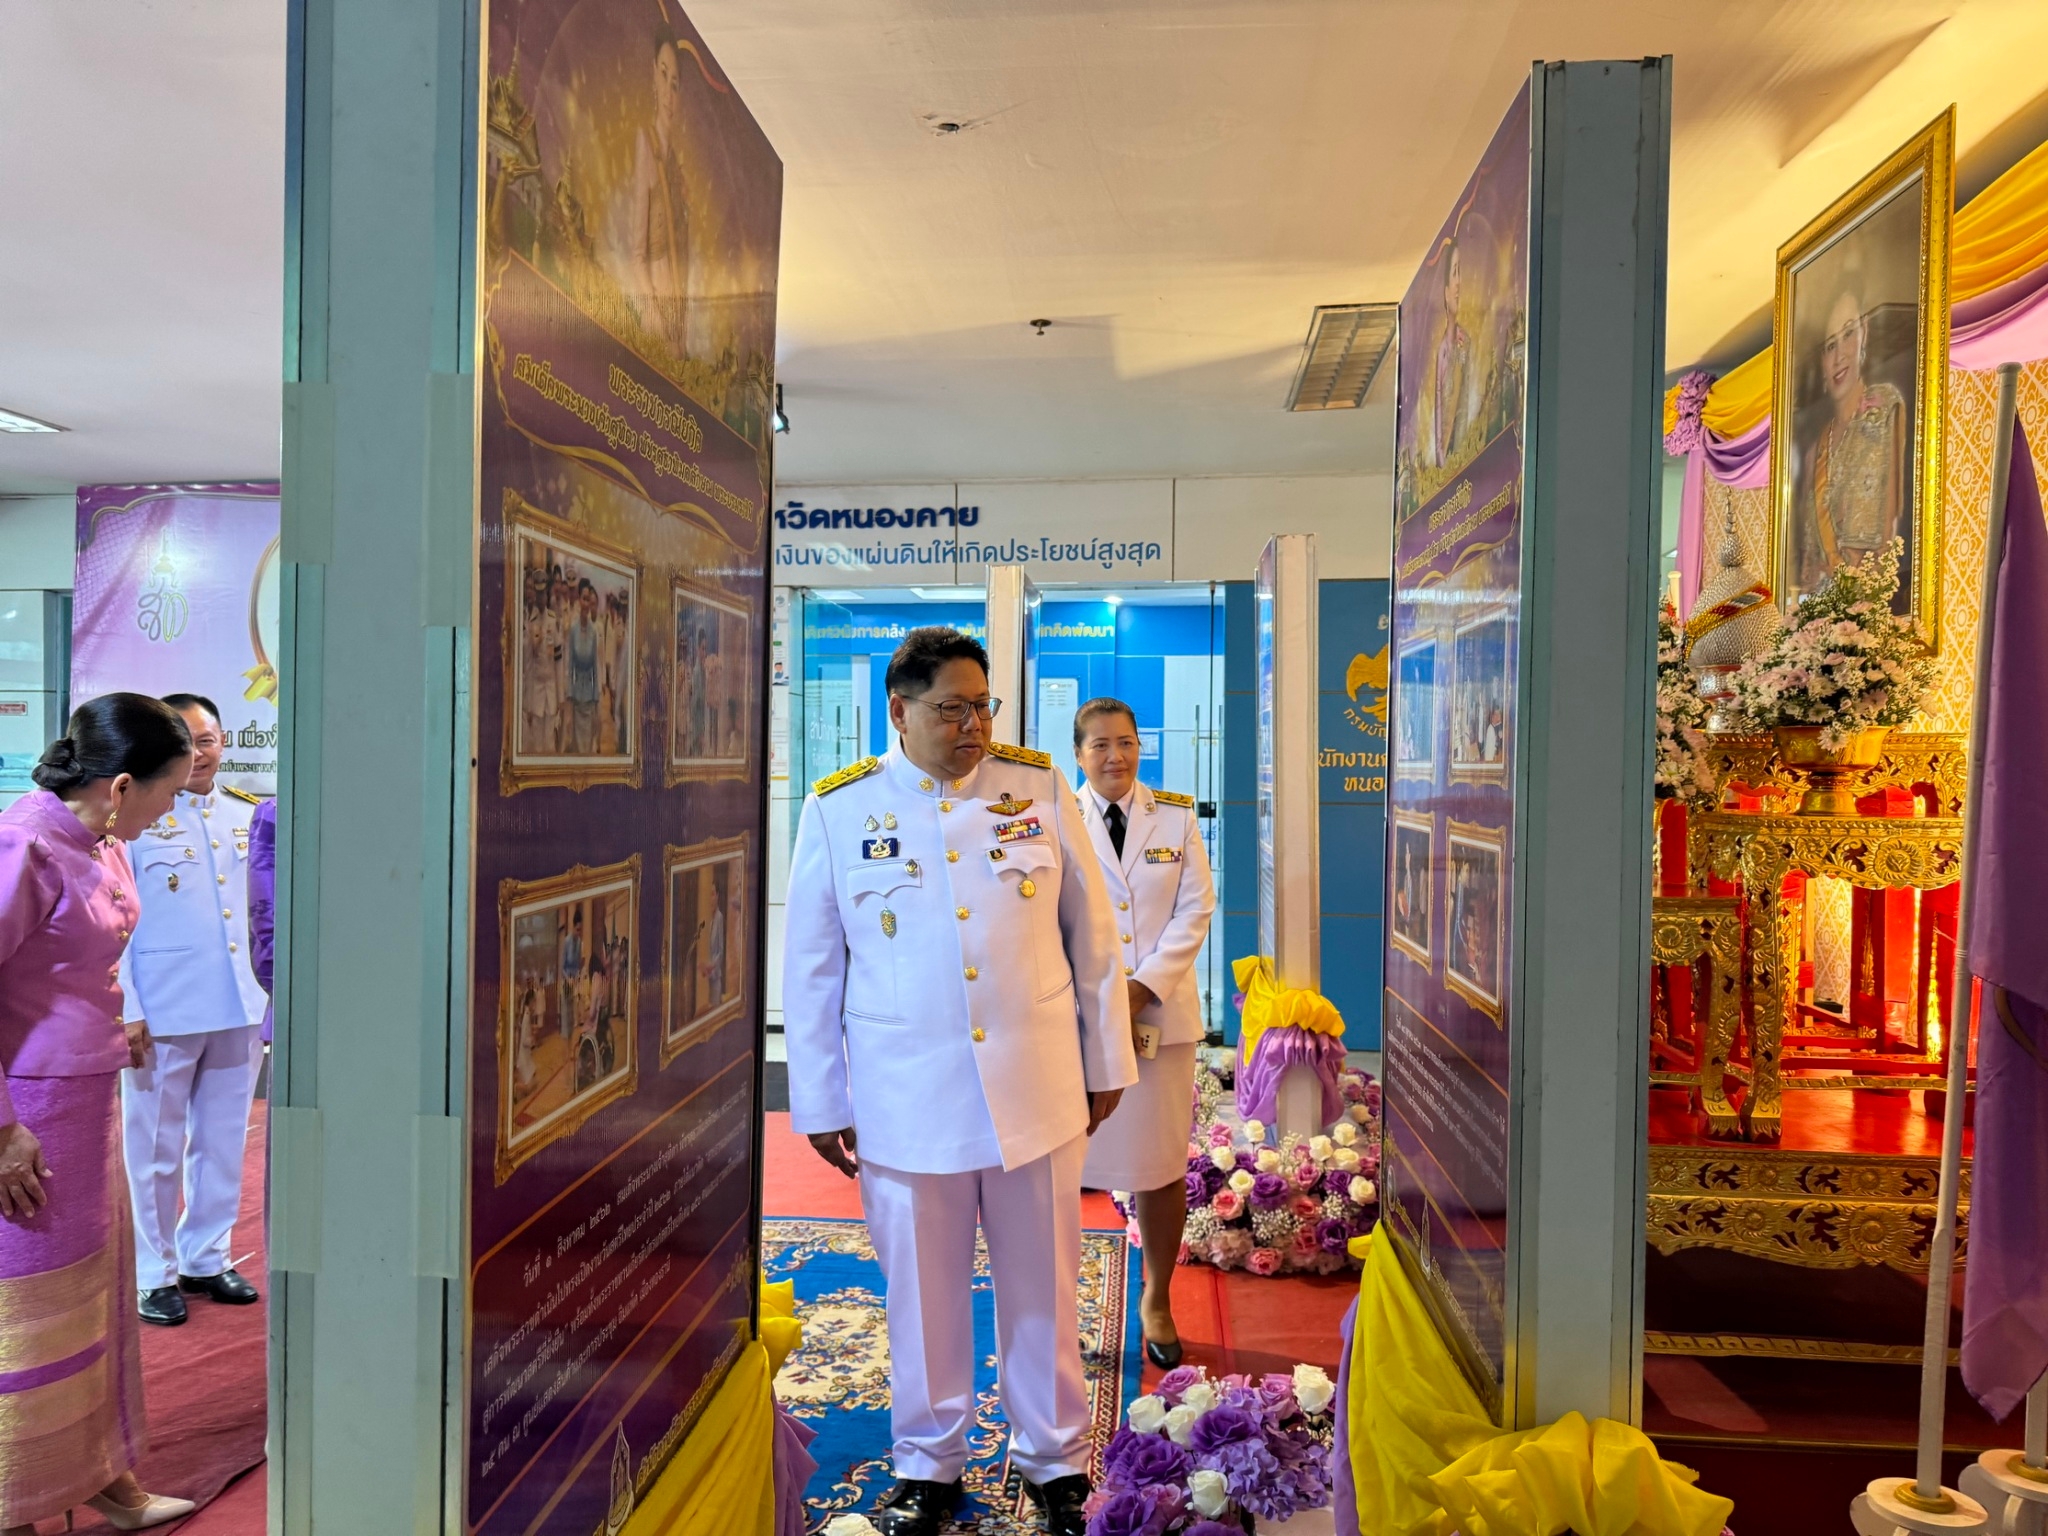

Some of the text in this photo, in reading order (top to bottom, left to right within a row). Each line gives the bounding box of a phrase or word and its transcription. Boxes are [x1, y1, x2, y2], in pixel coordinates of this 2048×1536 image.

[609, 364, 703, 451] พระราชกรณียกิจ
[238, 719, 278, 748] เนื่อง
[1344, 776, 1386, 792] หนอ
[523, 1246, 540, 1291] วันที่
[556, 1214, 585, 1260] สิงหาคม
[589, 1198, 610, 1230] ๒๕๖๒
